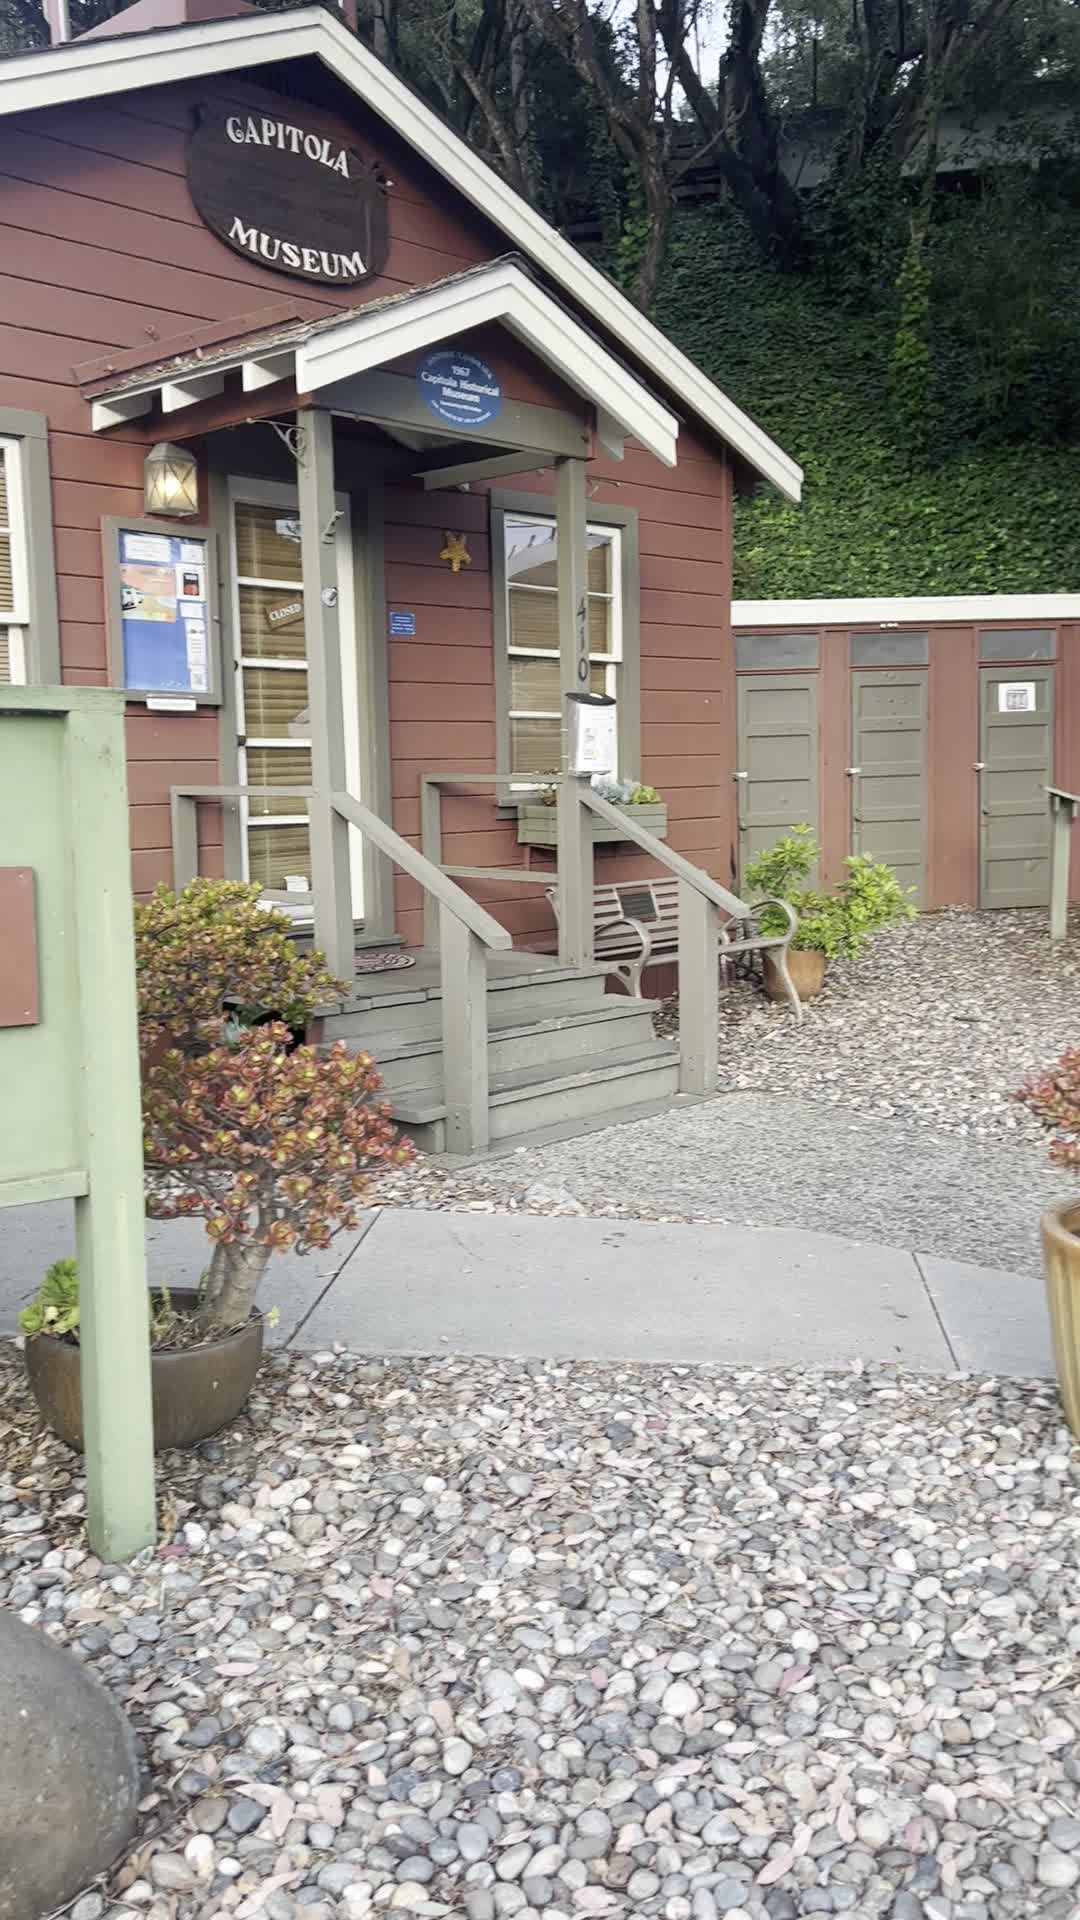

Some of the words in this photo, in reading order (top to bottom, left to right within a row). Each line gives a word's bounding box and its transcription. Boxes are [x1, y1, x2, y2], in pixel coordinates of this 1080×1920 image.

[226, 116, 349, 178] CAPITOLA
[228, 216, 367, 277] MUSEUM
[421, 371, 458, 388] Capitola
[442, 386, 480, 402] Museum
[269, 603, 302, 621] CLOSED
